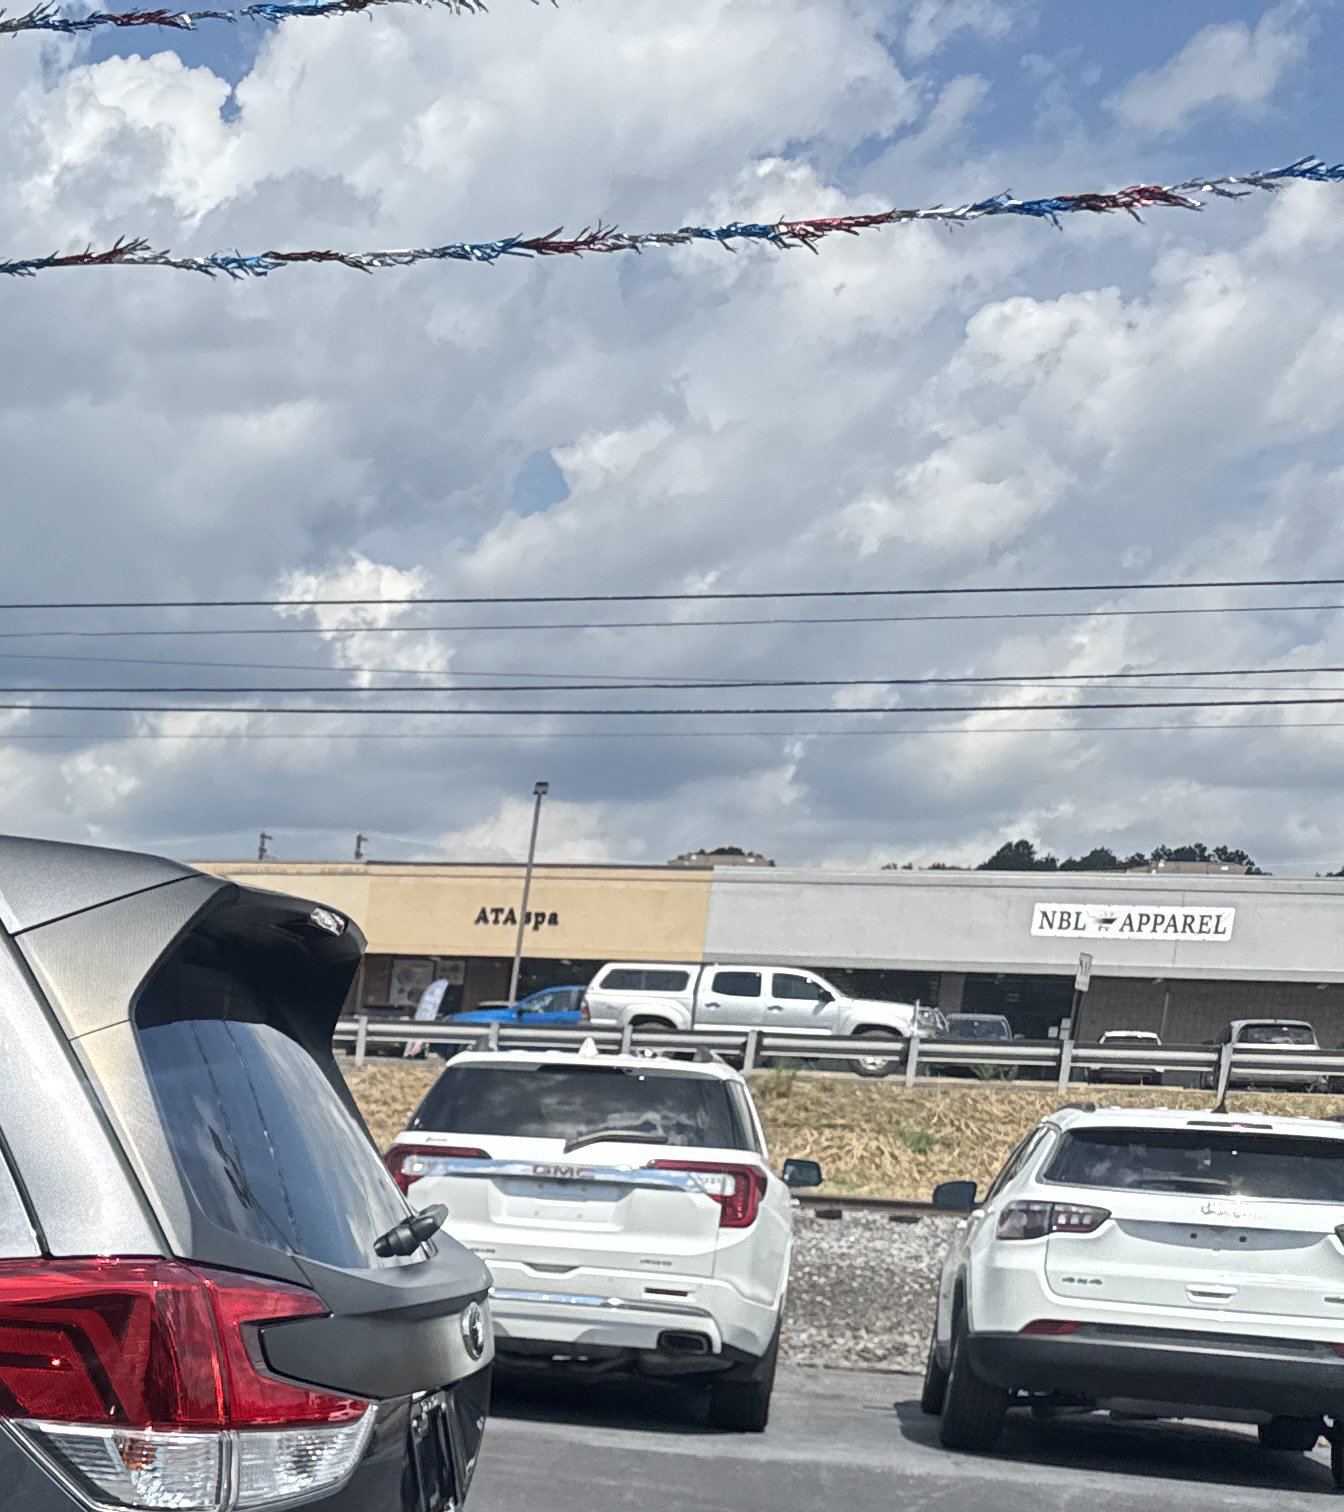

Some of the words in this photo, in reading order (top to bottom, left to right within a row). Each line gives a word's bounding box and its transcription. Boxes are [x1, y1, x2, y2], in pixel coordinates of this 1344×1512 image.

[474, 906, 517, 926] ATA
[523, 911, 559, 931] spa
[1038, 910, 1087, 931] NBL
[1118, 912, 1227, 935] APPAREL
[532, 1163, 595, 1180] GMC
